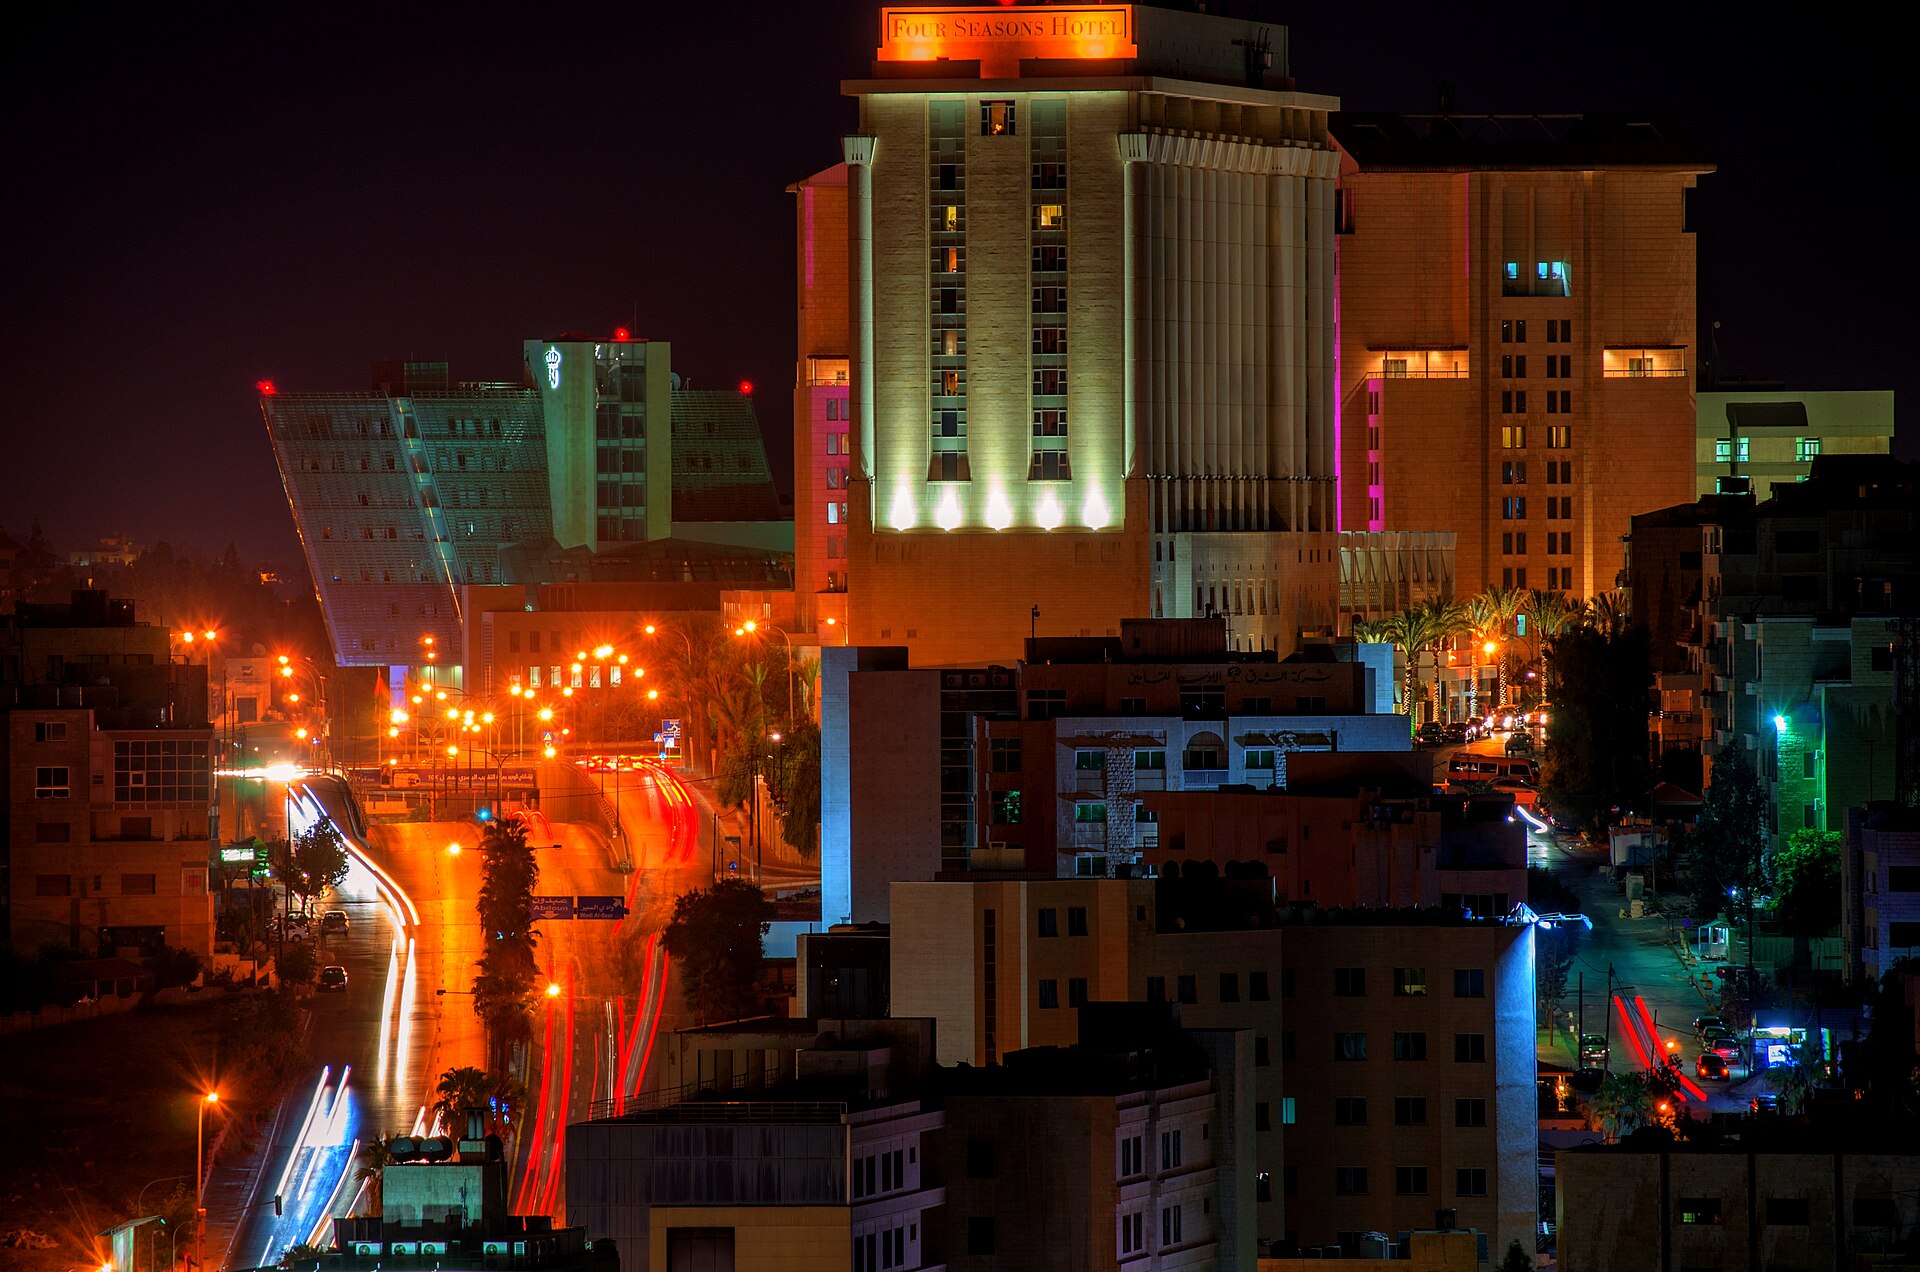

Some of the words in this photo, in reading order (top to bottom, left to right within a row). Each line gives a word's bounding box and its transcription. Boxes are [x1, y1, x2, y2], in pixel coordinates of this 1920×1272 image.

[891, 18, 947, 38] FOUR
[954, 17, 1044, 37] SEASONS
[1049, 16, 1124, 36] HOTEL
[1244, 669, 1286, 685] الشرق
[1291, 668, 1333, 684] شركة
[532, 898, 568, 906] عبدون
